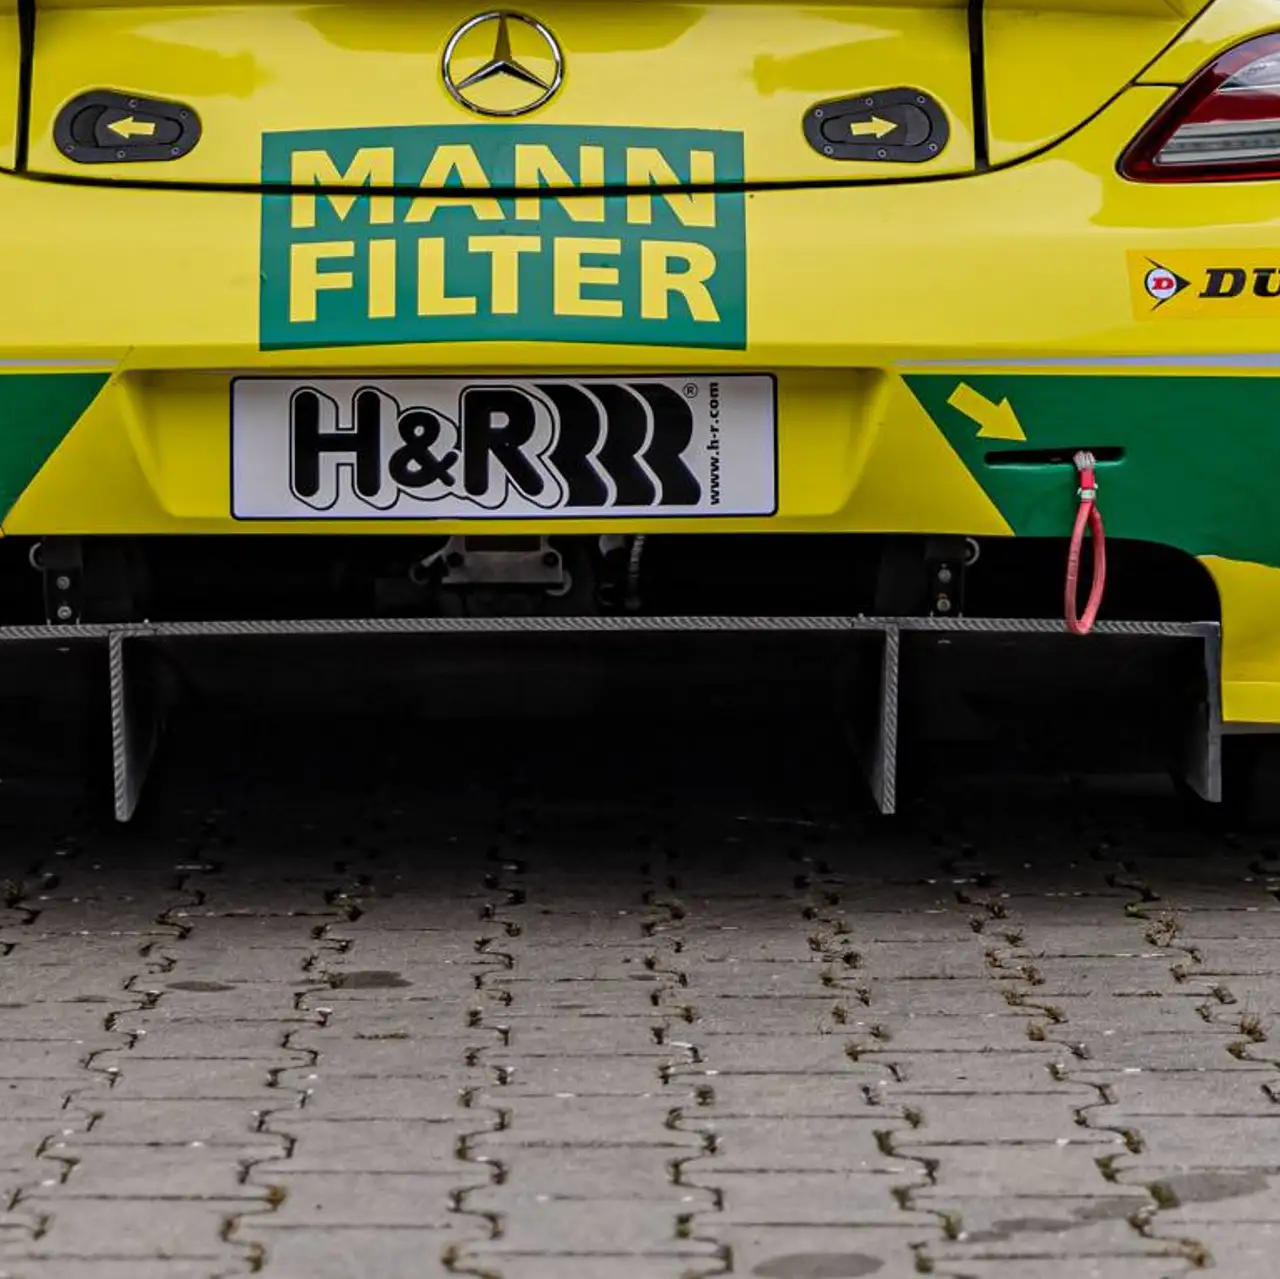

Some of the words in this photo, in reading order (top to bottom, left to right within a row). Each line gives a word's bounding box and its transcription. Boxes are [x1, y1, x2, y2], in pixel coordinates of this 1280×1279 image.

[291, 144, 716, 228] MANN
[289, 236, 721, 323] FILTER
[707, 382, 720, 506] www.h-r.com
